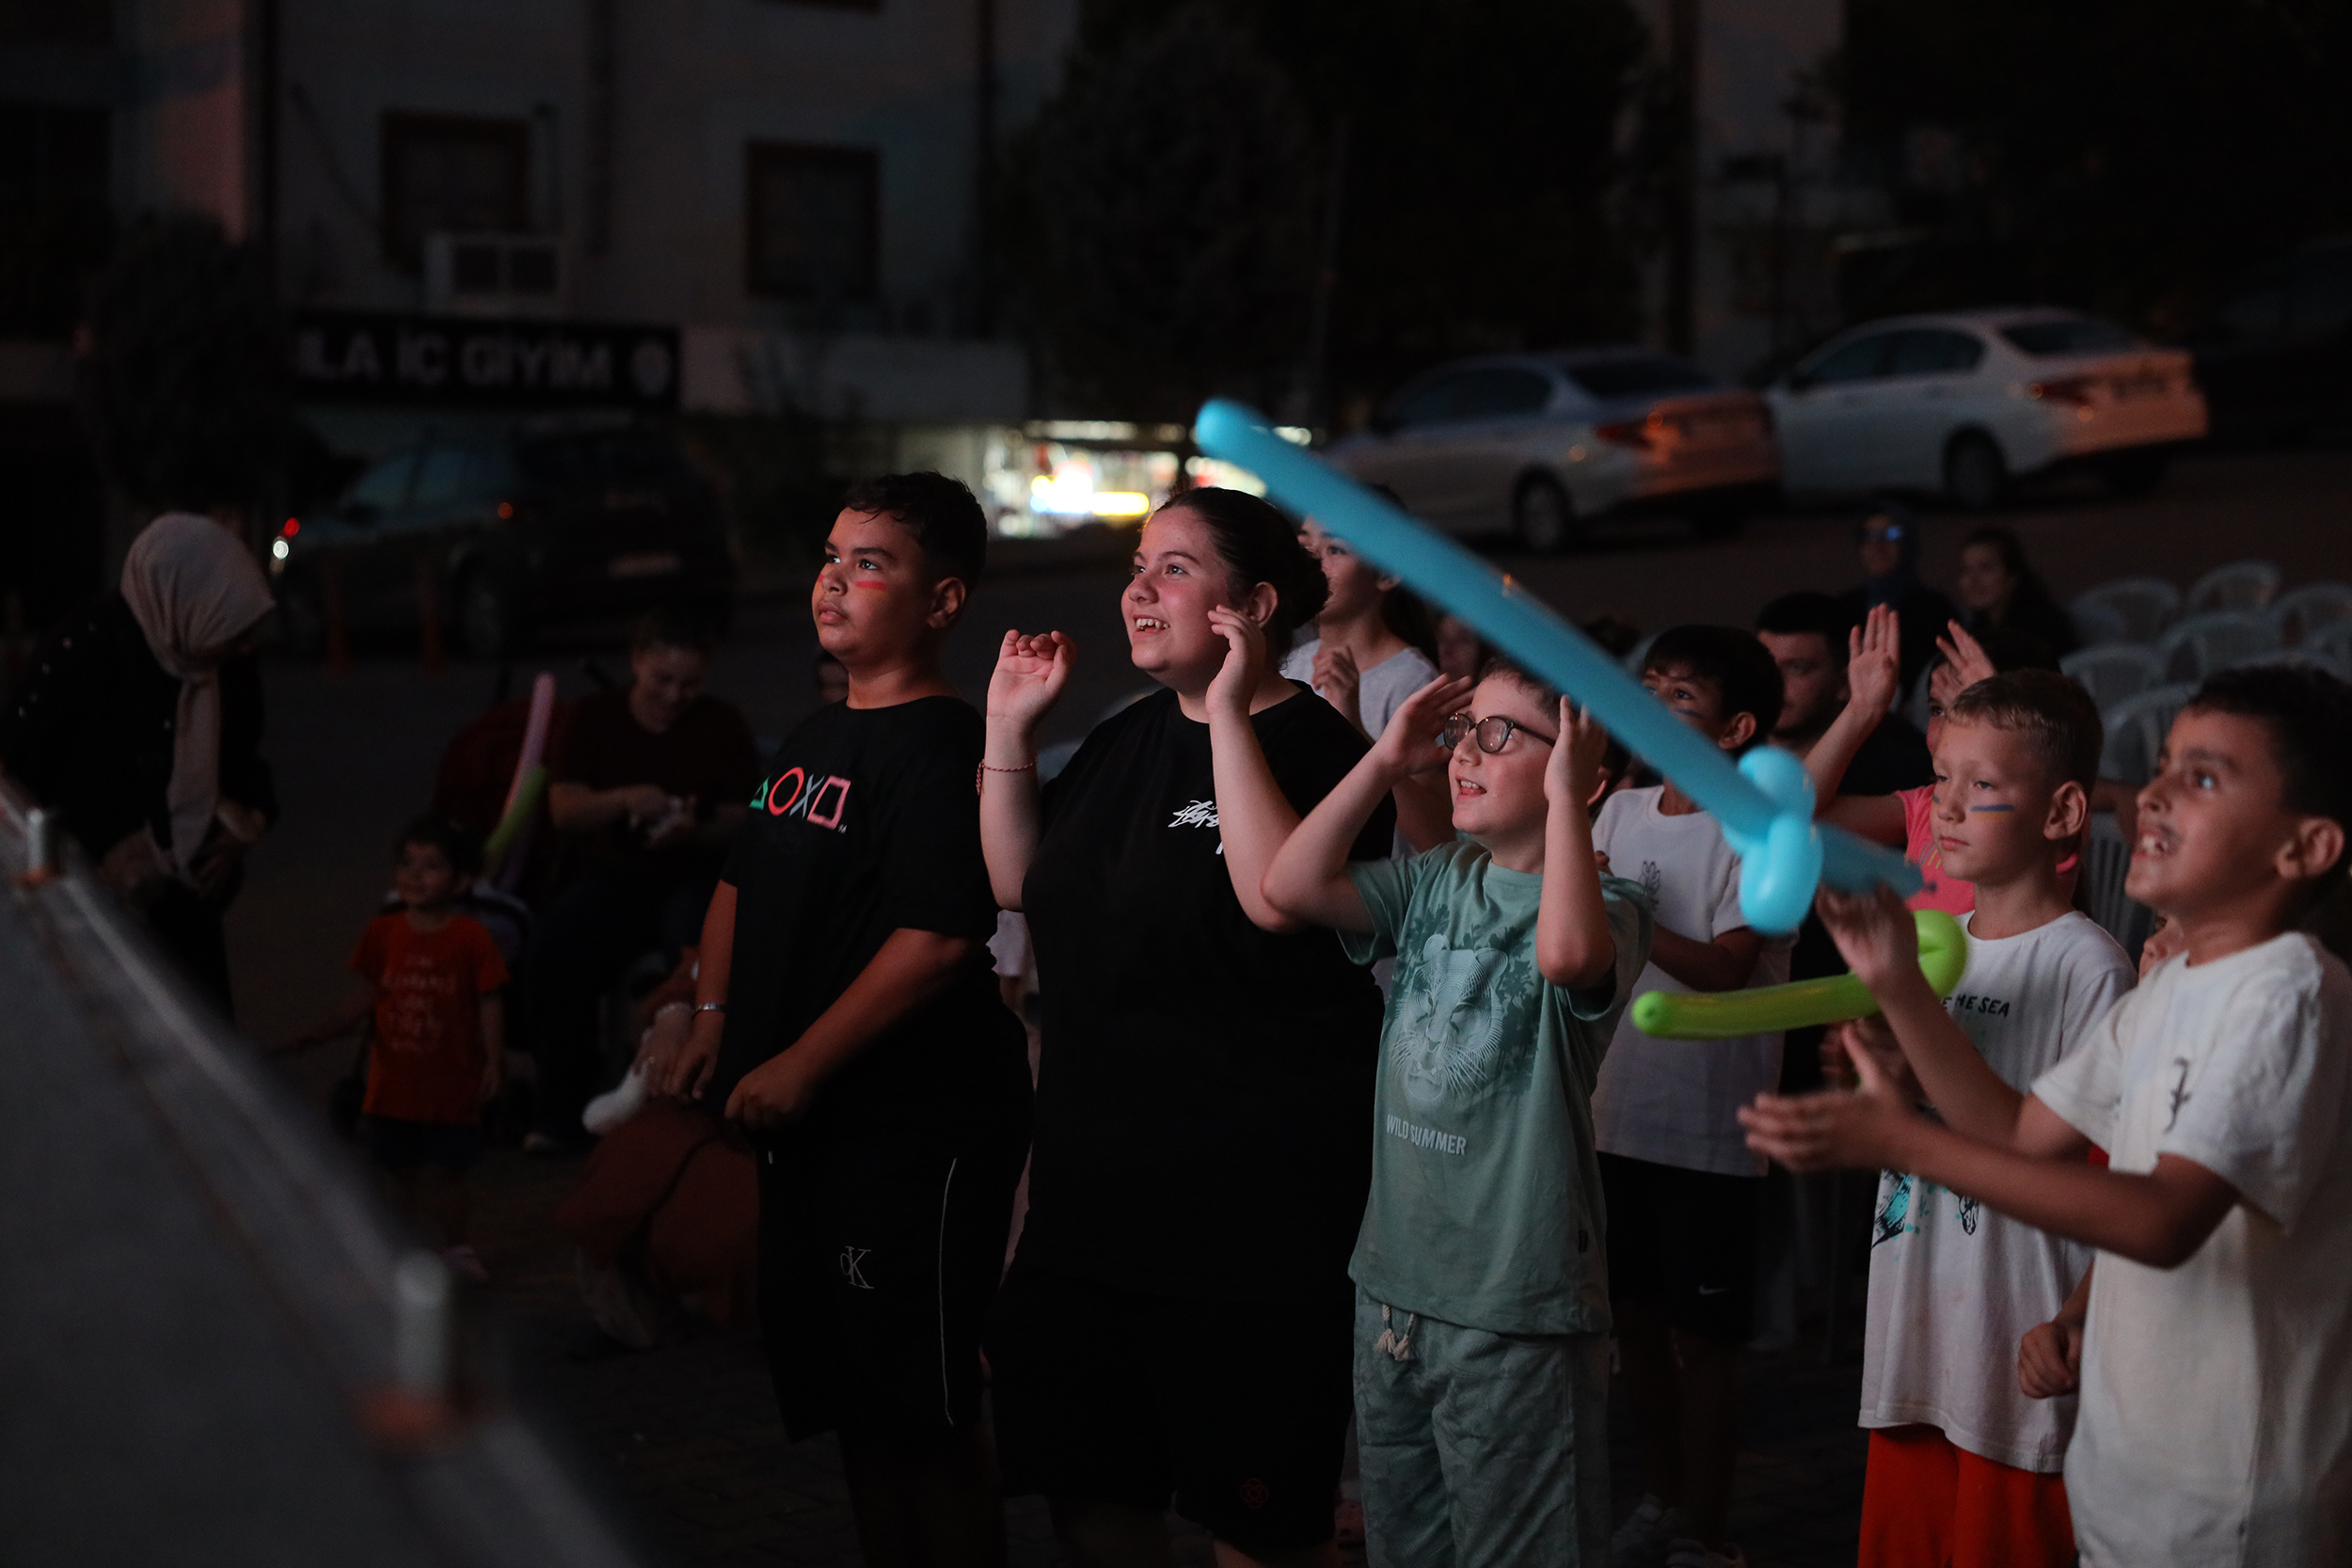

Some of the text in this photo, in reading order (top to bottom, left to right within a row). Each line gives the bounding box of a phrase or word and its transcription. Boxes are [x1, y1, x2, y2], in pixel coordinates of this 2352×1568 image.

[1955, 993, 1978, 1010] HE
[1979, 997, 2010, 1017] SEA
[1386, 1114, 1468, 1156] WILD SUMMER
